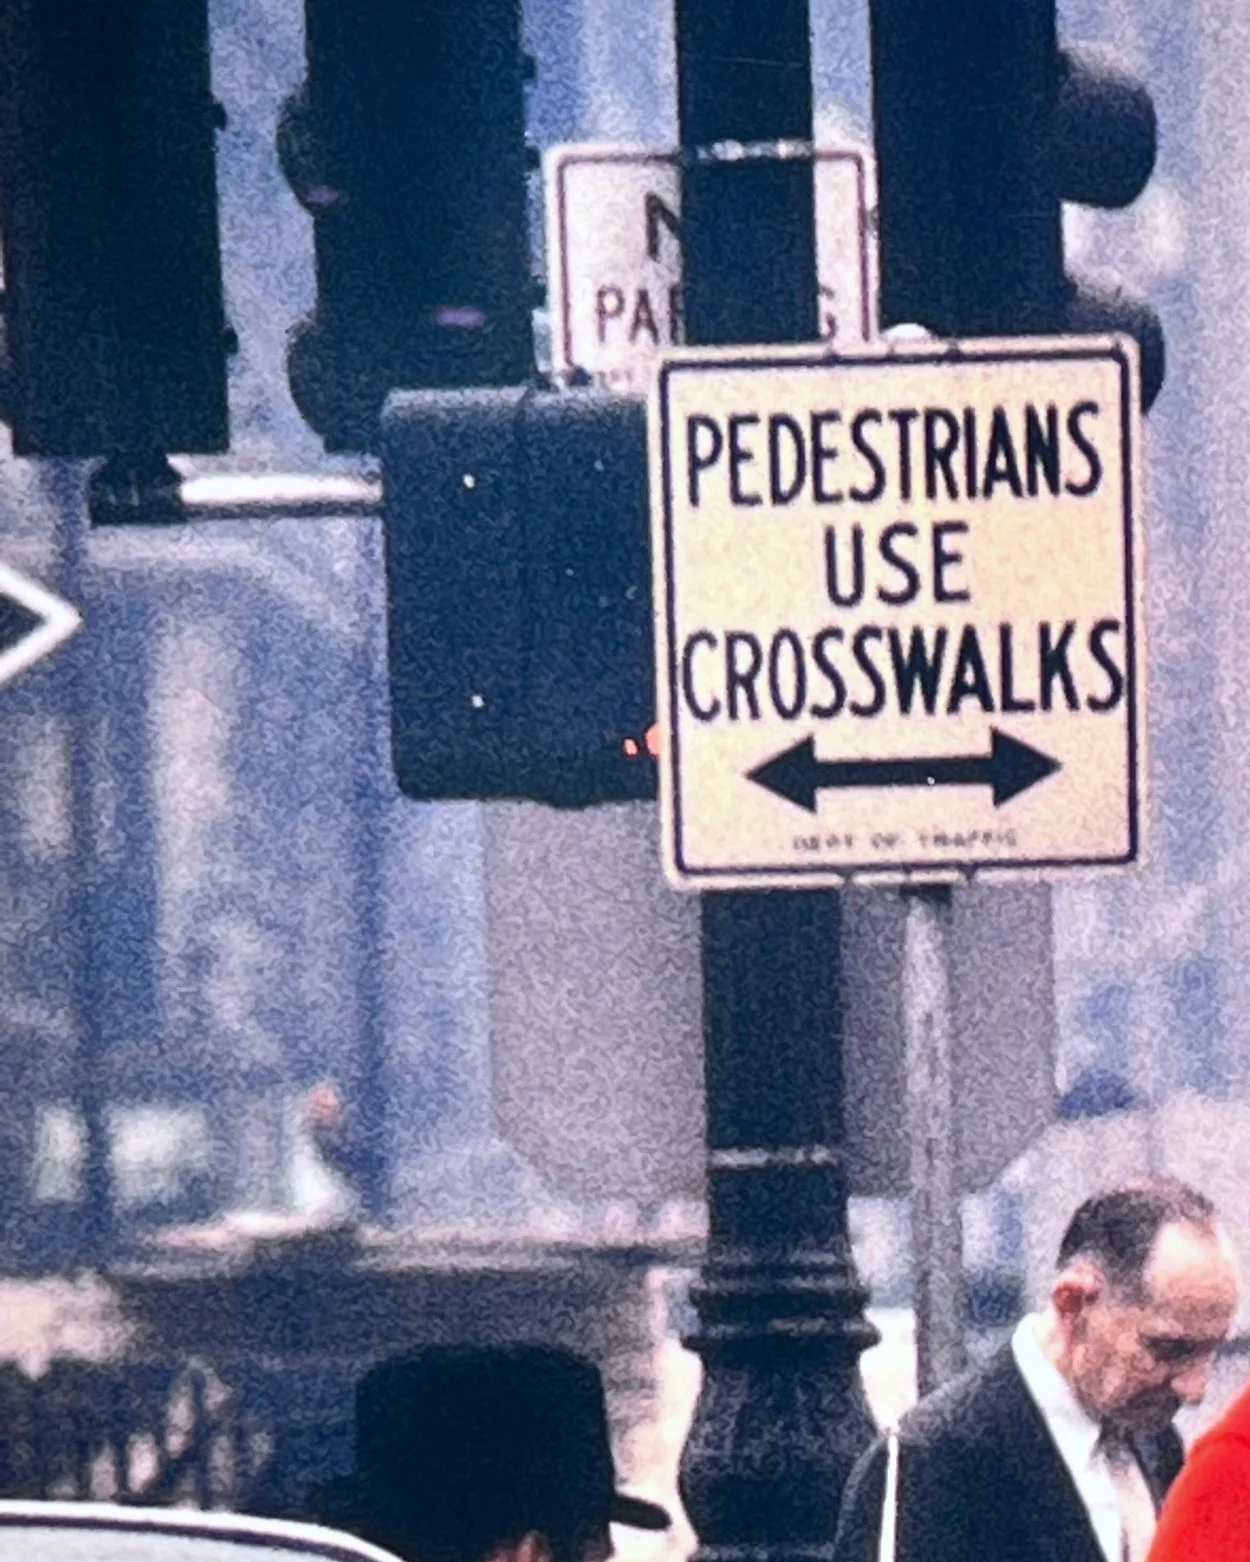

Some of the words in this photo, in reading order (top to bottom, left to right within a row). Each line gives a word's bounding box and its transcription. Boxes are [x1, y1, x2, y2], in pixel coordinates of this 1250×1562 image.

[685, 402, 1102, 507] PEDESTRIANS
[823, 521, 970, 607] USE
[681, 619, 1125, 722] CROSSWALKS
